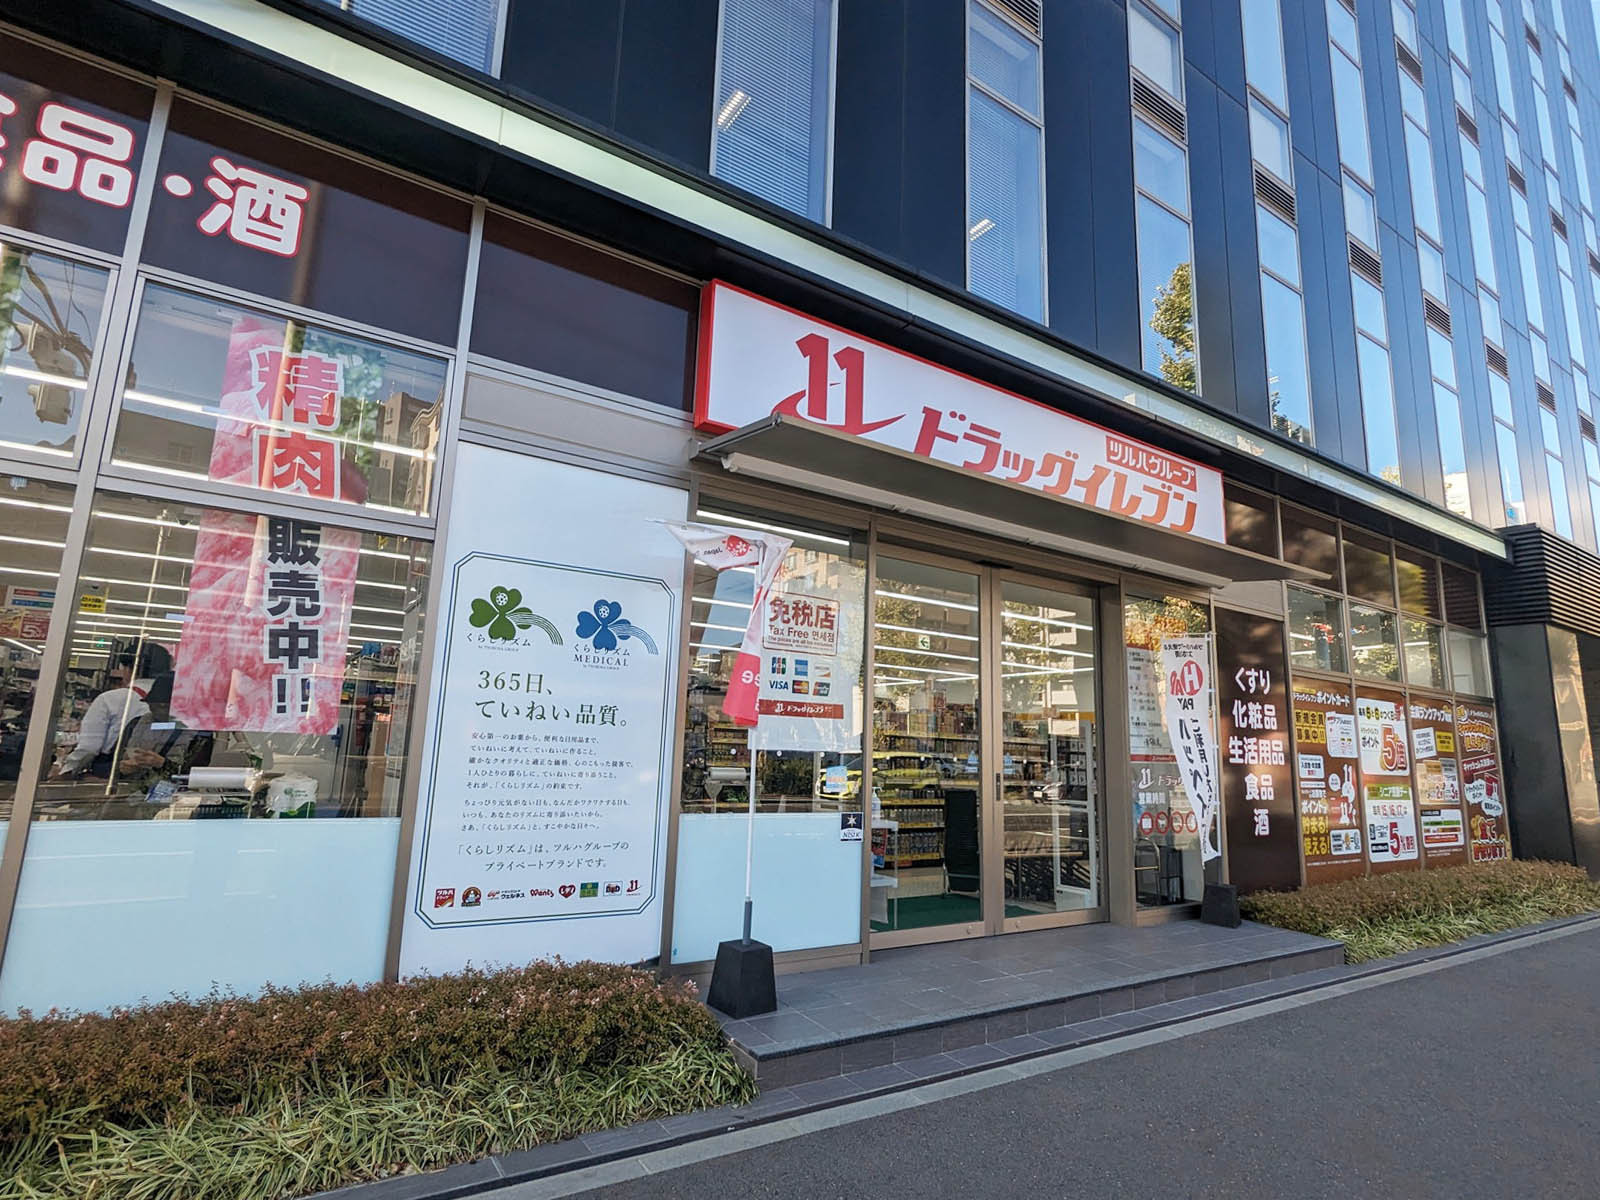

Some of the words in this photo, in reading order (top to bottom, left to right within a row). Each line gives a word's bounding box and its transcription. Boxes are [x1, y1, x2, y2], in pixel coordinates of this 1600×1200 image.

[0, 93, 309, 257] 品・酒
[913, 404, 1197, 533] ドラッグイレブン
[1108, 438, 1196, 488] ツルハグループ
[768, 595, 836, 631] 免税店
[768, 624, 785, 637] Tax
[788, 627, 809, 639] Free
[573, 654, 629, 667] MEDICAL
[477, 670, 552, 696] 365日、
[769, 679, 789, 691] VISA
[1234, 667, 1271, 695] くすり
[475, 700, 628, 728] ていねい品質。
[1232, 700, 1278, 730] 化粧品
[1229, 736, 1285, 766] 生活用品
[1244, 773, 1274, 801] 食品
[1253, 808, 1270, 836] 酒
